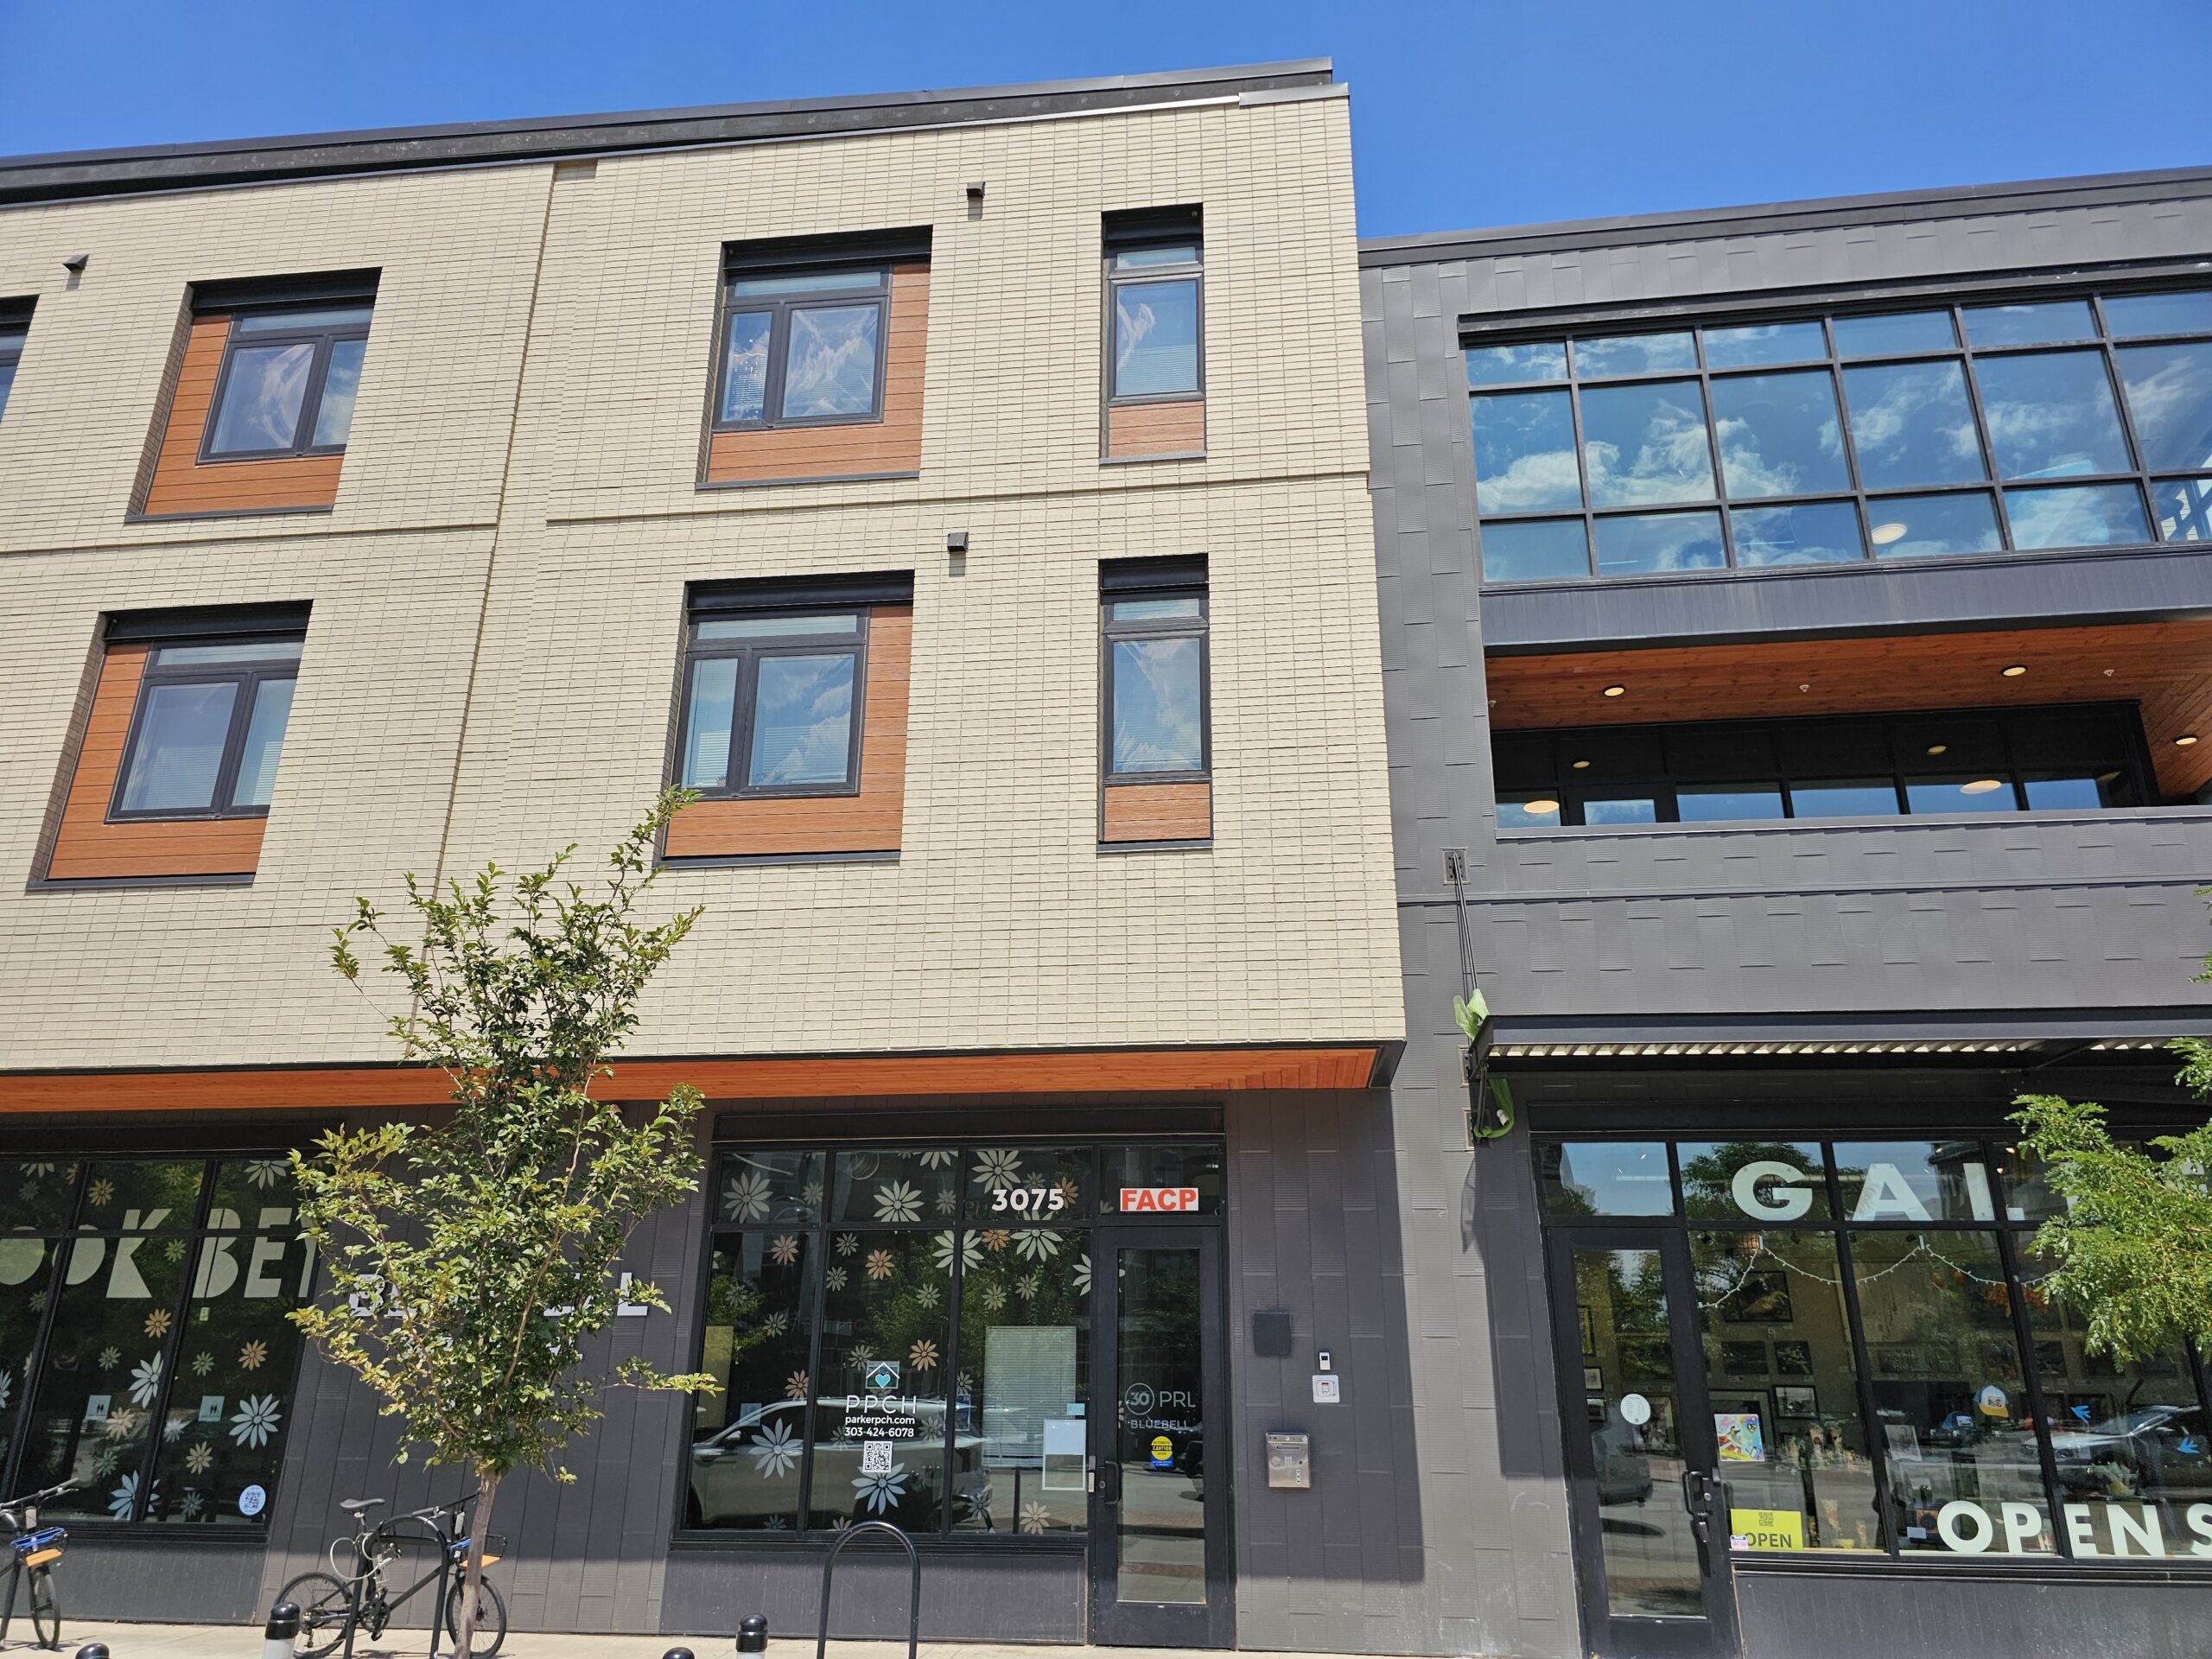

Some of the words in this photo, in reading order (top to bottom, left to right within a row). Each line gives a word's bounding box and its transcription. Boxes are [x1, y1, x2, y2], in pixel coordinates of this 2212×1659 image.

[991, 1188, 1065, 1211] 3075
[1122, 1189, 1197, 1211] FACP
[845, 1395, 917, 1414] PPCH
[1160, 1390, 1197, 1408] PRL
[844, 1414, 916, 1427] parkerpch.com
[1130, 1419, 1190, 1430] BLUEBELL
[844, 1427, 914, 1438] 303-424-6078
[1745, 1532, 1793, 1548] OPEN
